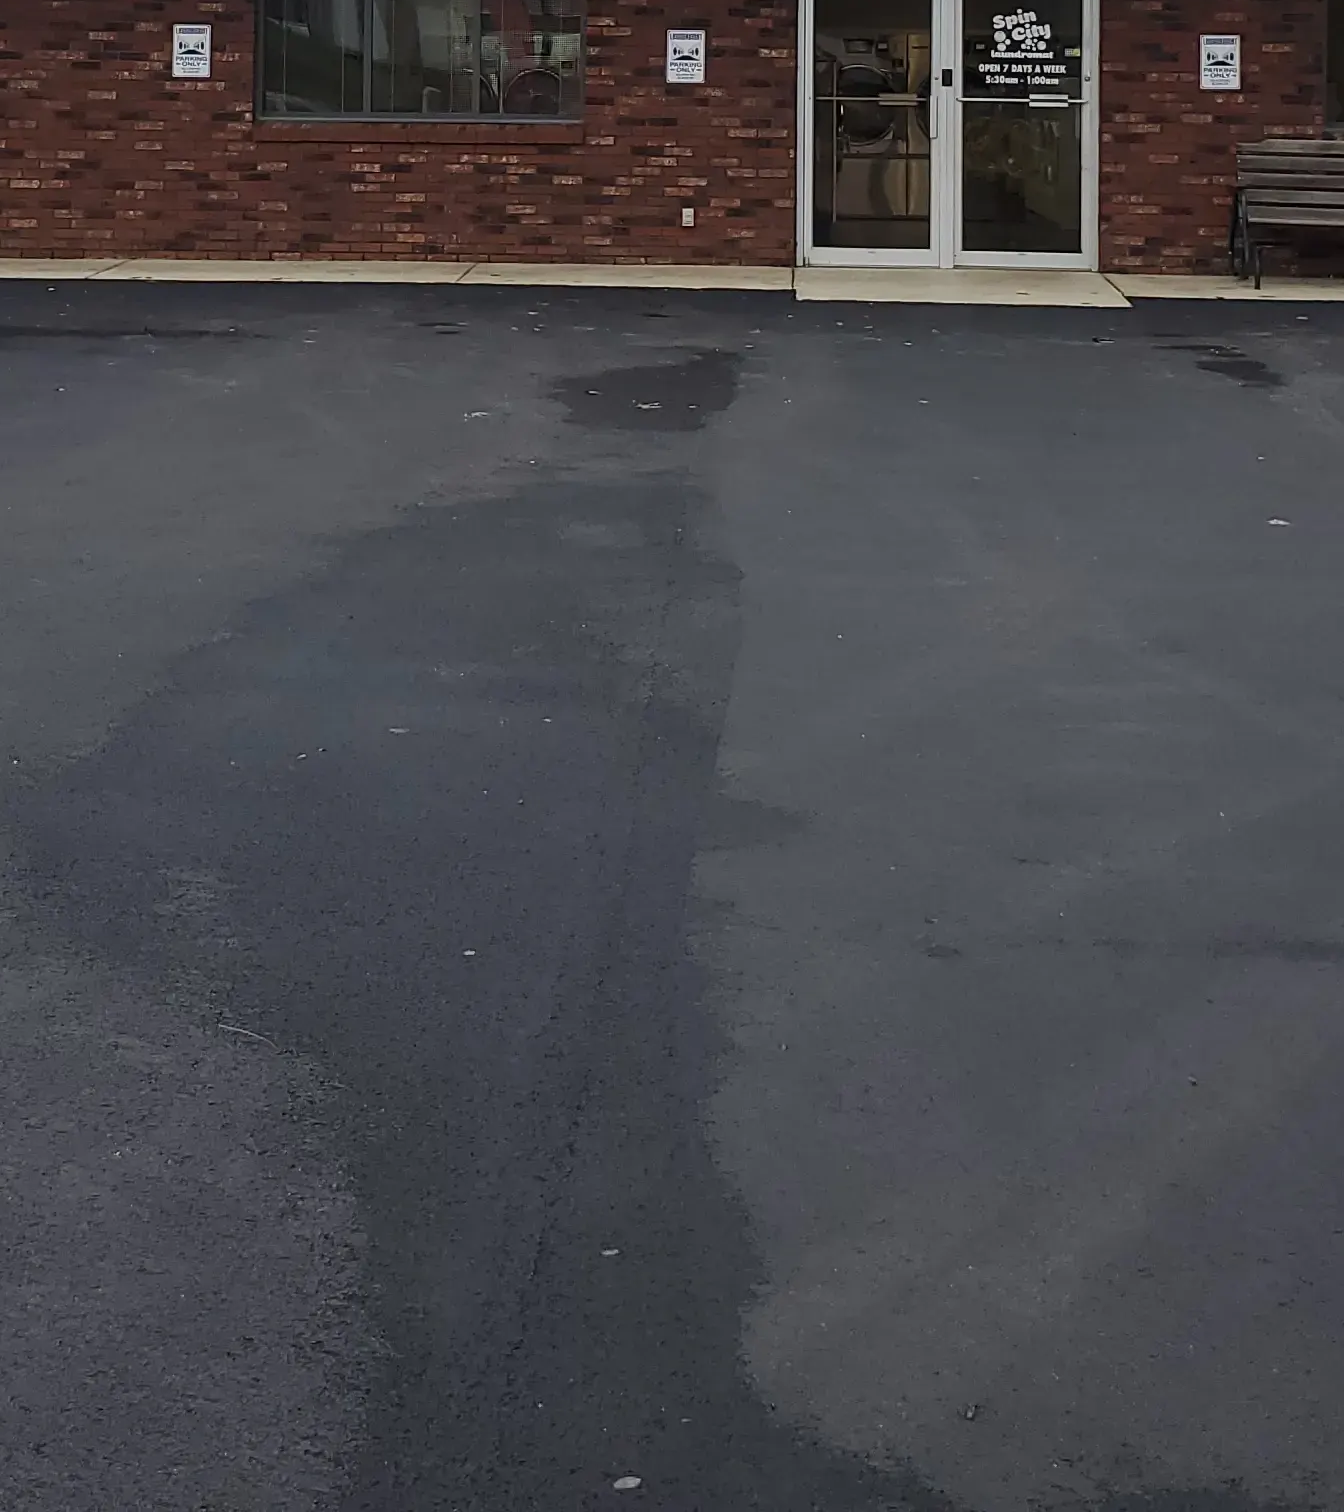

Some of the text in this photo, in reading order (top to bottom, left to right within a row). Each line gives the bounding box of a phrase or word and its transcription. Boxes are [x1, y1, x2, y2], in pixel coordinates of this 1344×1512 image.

[992, 8, 1037, 30] Spin
[1011, 23, 1051, 40] City
[990, 49, 1054, 59] laundromat
[978, 63, 1067, 74] OPEN 7 DAYS A WEEK
[985, 74, 1019, 84] 5:30am
[1026, 75, 1059, 85] 1:00am
